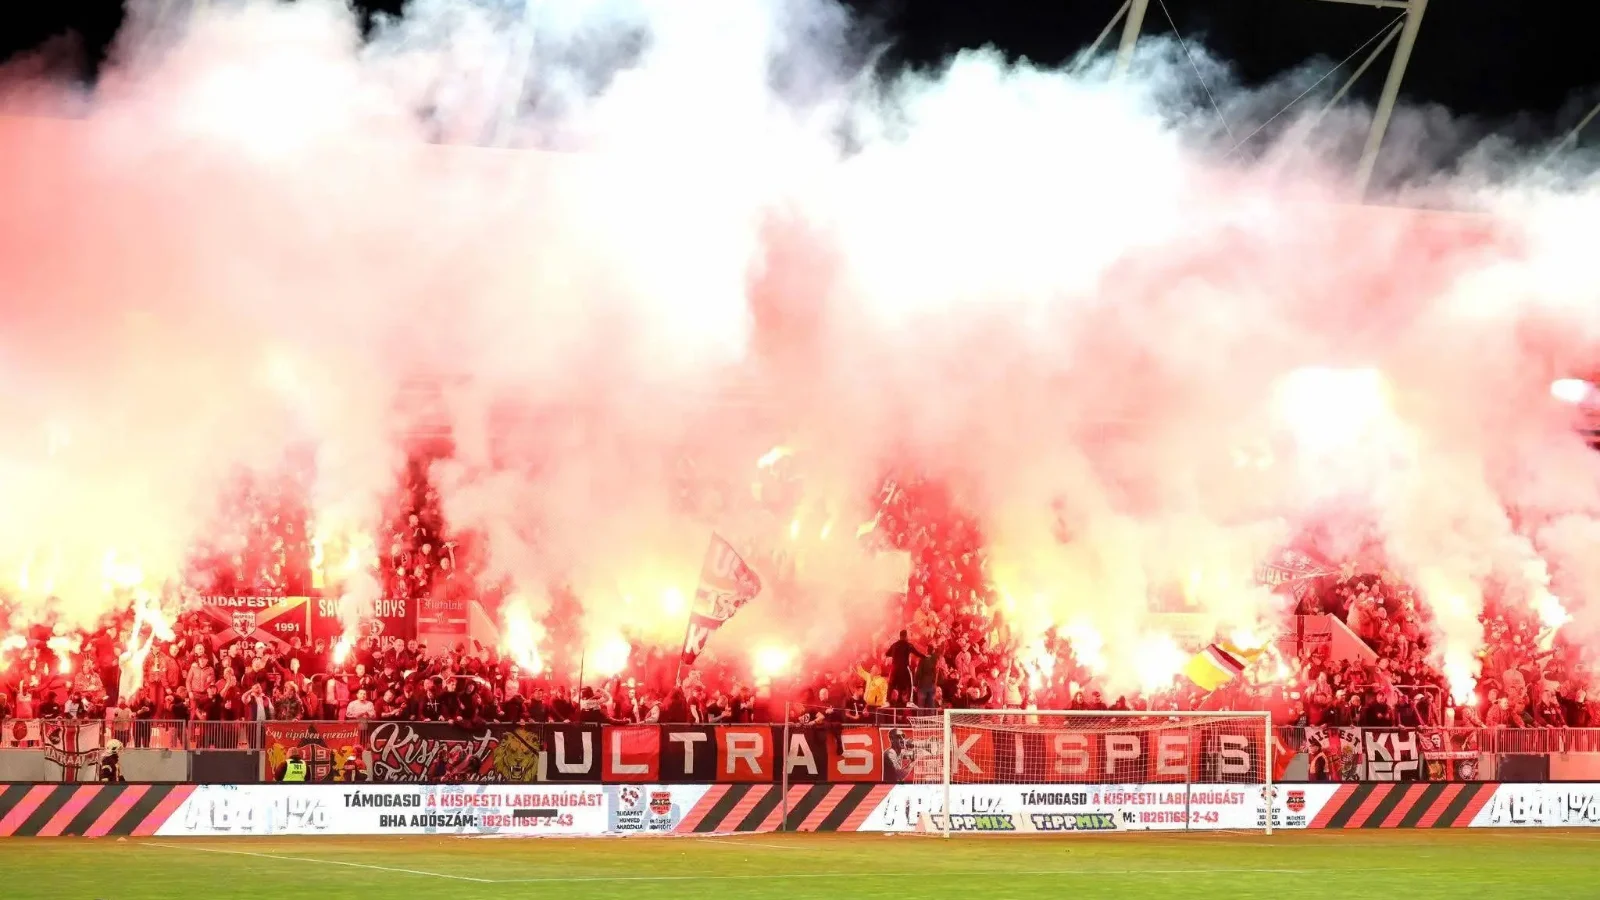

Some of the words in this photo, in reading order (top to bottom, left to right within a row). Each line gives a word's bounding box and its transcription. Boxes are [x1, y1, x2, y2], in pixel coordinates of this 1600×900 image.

[201, 595, 288, 608] BUDAPEST'S
[375, 599, 406, 617] BOYS
[274, 622, 300, 632] 1991
[554, 731, 874, 775] ULTRAS
[344, 790, 421, 807] TÁMOGASD
[427, 794, 437, 807] A
[440, 794, 502, 807] KISPESTI
[505, 791, 604, 808] LABDARÚGÁST
[1021, 789, 1087, 805] TÁMOGASD
[1092, 792, 1101, 805] A
[1104, 792, 1156, 805] KISPESTI
[379, 814, 407, 827] BHA
[410, 811, 478, 827] ADÓSZÁM:
[1139, 811, 1219, 823] 18261169-2-43
